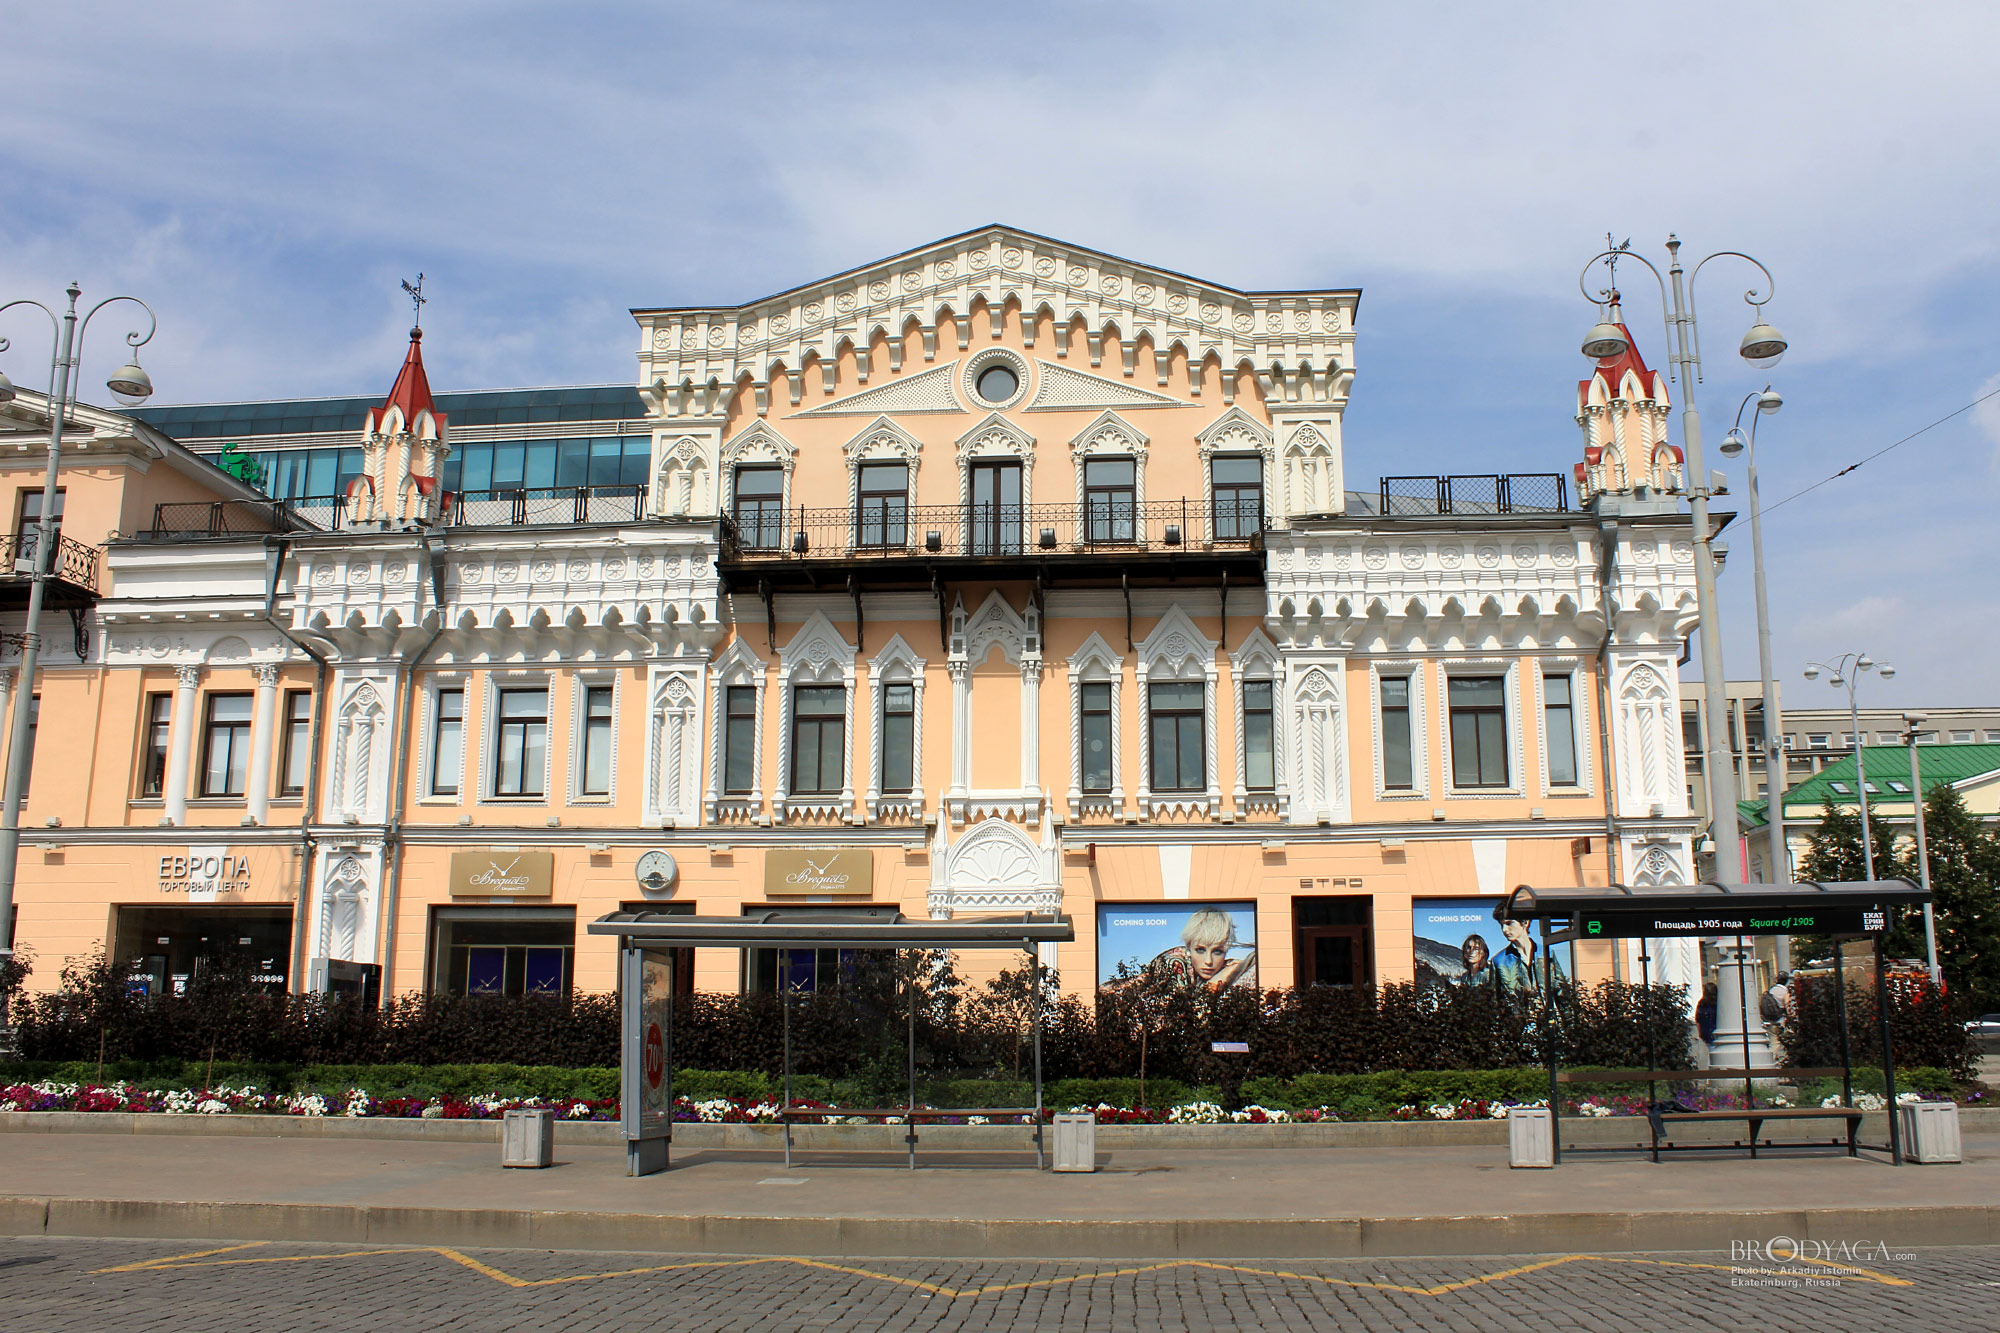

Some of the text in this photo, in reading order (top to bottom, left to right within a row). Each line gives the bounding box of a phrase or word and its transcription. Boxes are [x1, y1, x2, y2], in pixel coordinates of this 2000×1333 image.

[159, 855, 251, 879] ЕВРОПА
[469, 869, 529, 891] Breguet
[786, 867, 849, 889] Breguet
[159, 880, 250, 893] ТОРГОВЫЙ ЦЕНТР
[1113, 918, 1167, 927] COMING SOON
[1428, 914, 1482, 923] COMING SOON
[1654, 919, 1743, 930] Площадь 1905 года
[1750, 917, 1814, 929] Square of 1905
[647, 1044, 658, 1072] 70
